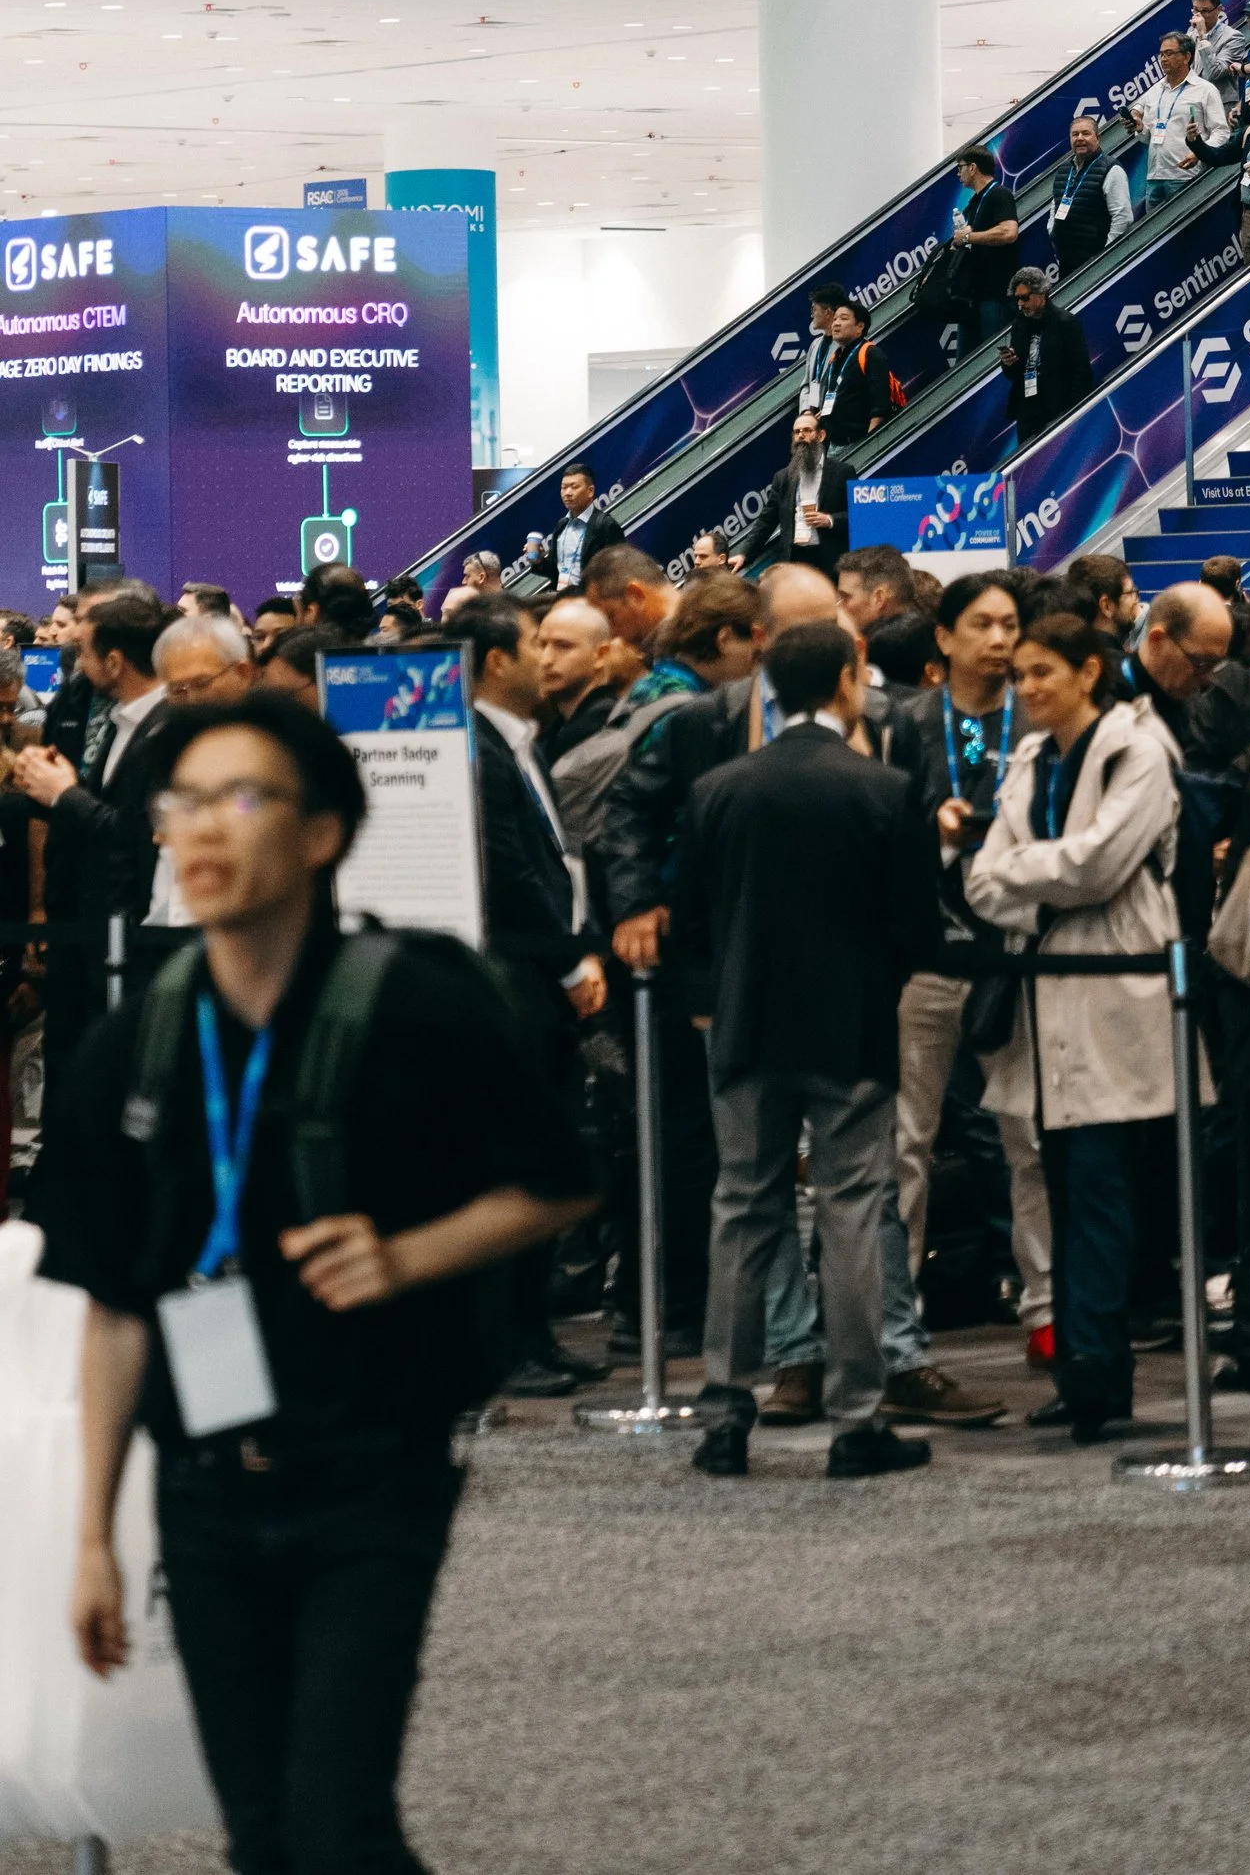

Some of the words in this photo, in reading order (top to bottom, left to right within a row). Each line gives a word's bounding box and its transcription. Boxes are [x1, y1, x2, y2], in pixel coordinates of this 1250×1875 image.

[308, 190, 333, 205] RSAC
[41, 239, 113, 280] SAFE
[297, 235, 397, 272] SAFE
[1154, 233, 1244, 319] Sentinel
[83, 304, 127, 329] CTEM
[236, 301, 357, 324] Autonomous
[361, 302, 409, 328] CRQ
[24, 356, 57, 377] ZERO
[59, 354, 83, 374] DAY
[84, 351, 143, 373] FINDINGS
[225, 348, 287, 368] BOARD
[289, 348, 327, 368] AND
[330, 348, 419, 368] EXECUTIVE
[276, 374, 372, 393] REPORTING
[853, 485, 887, 504] RSAC
[890, 493, 922, 502] Conference
[1202, 487, 1221, 498] Visit
[1222, 487, 1234, 498] Us
[1235, 486, 1244, 497] at
[353, 748, 397, 763] Partner
[402, 746, 439, 764] Badge
[369, 772, 425, 789] Scanning
